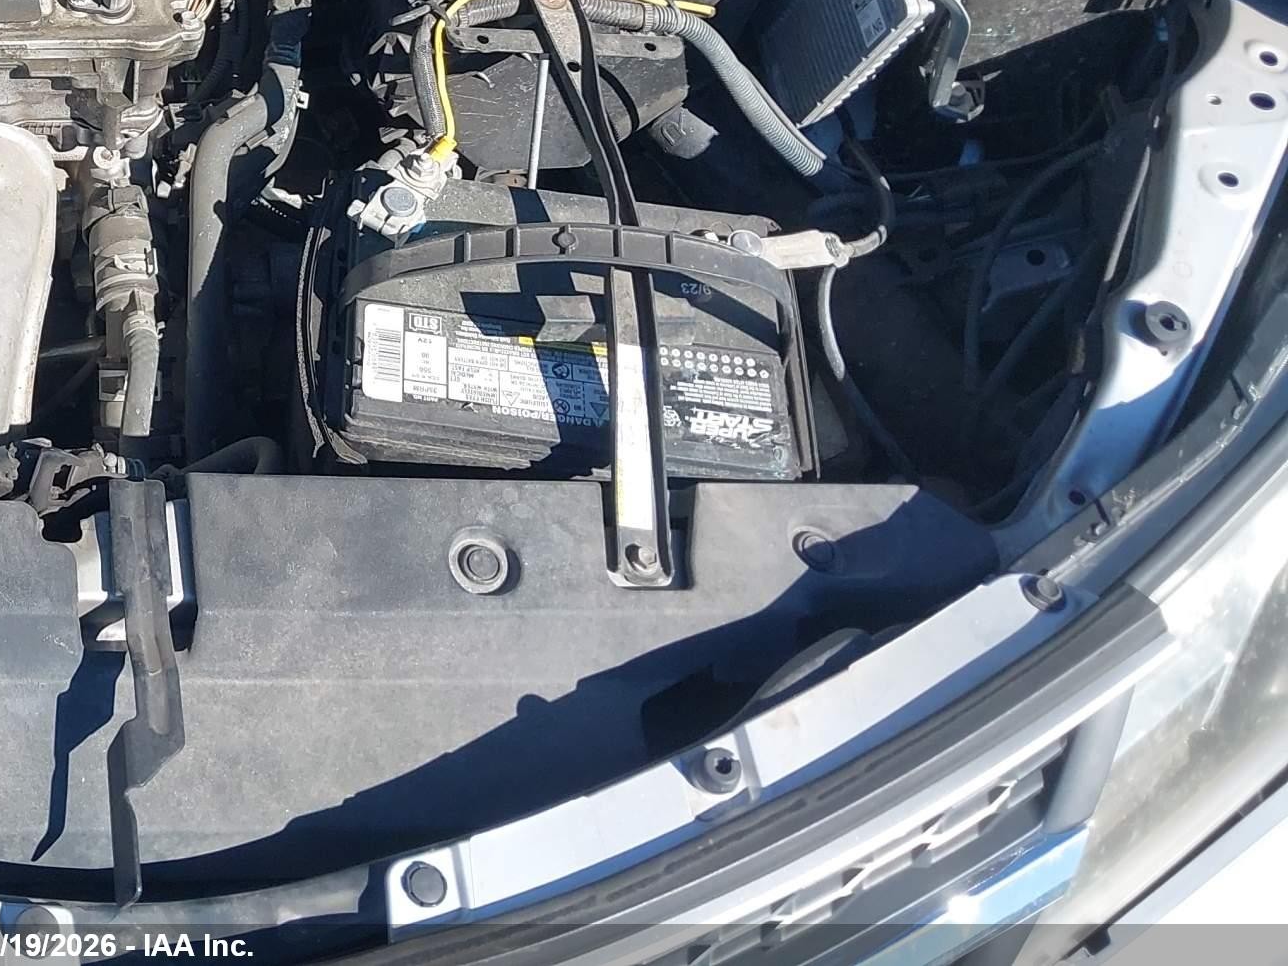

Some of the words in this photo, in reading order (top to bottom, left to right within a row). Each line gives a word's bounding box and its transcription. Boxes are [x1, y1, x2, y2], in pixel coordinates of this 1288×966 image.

[680, 282, 712, 296] 9/23
[492, 405, 594, 426] DANGER/POISON
[692, 411, 774, 433] START
